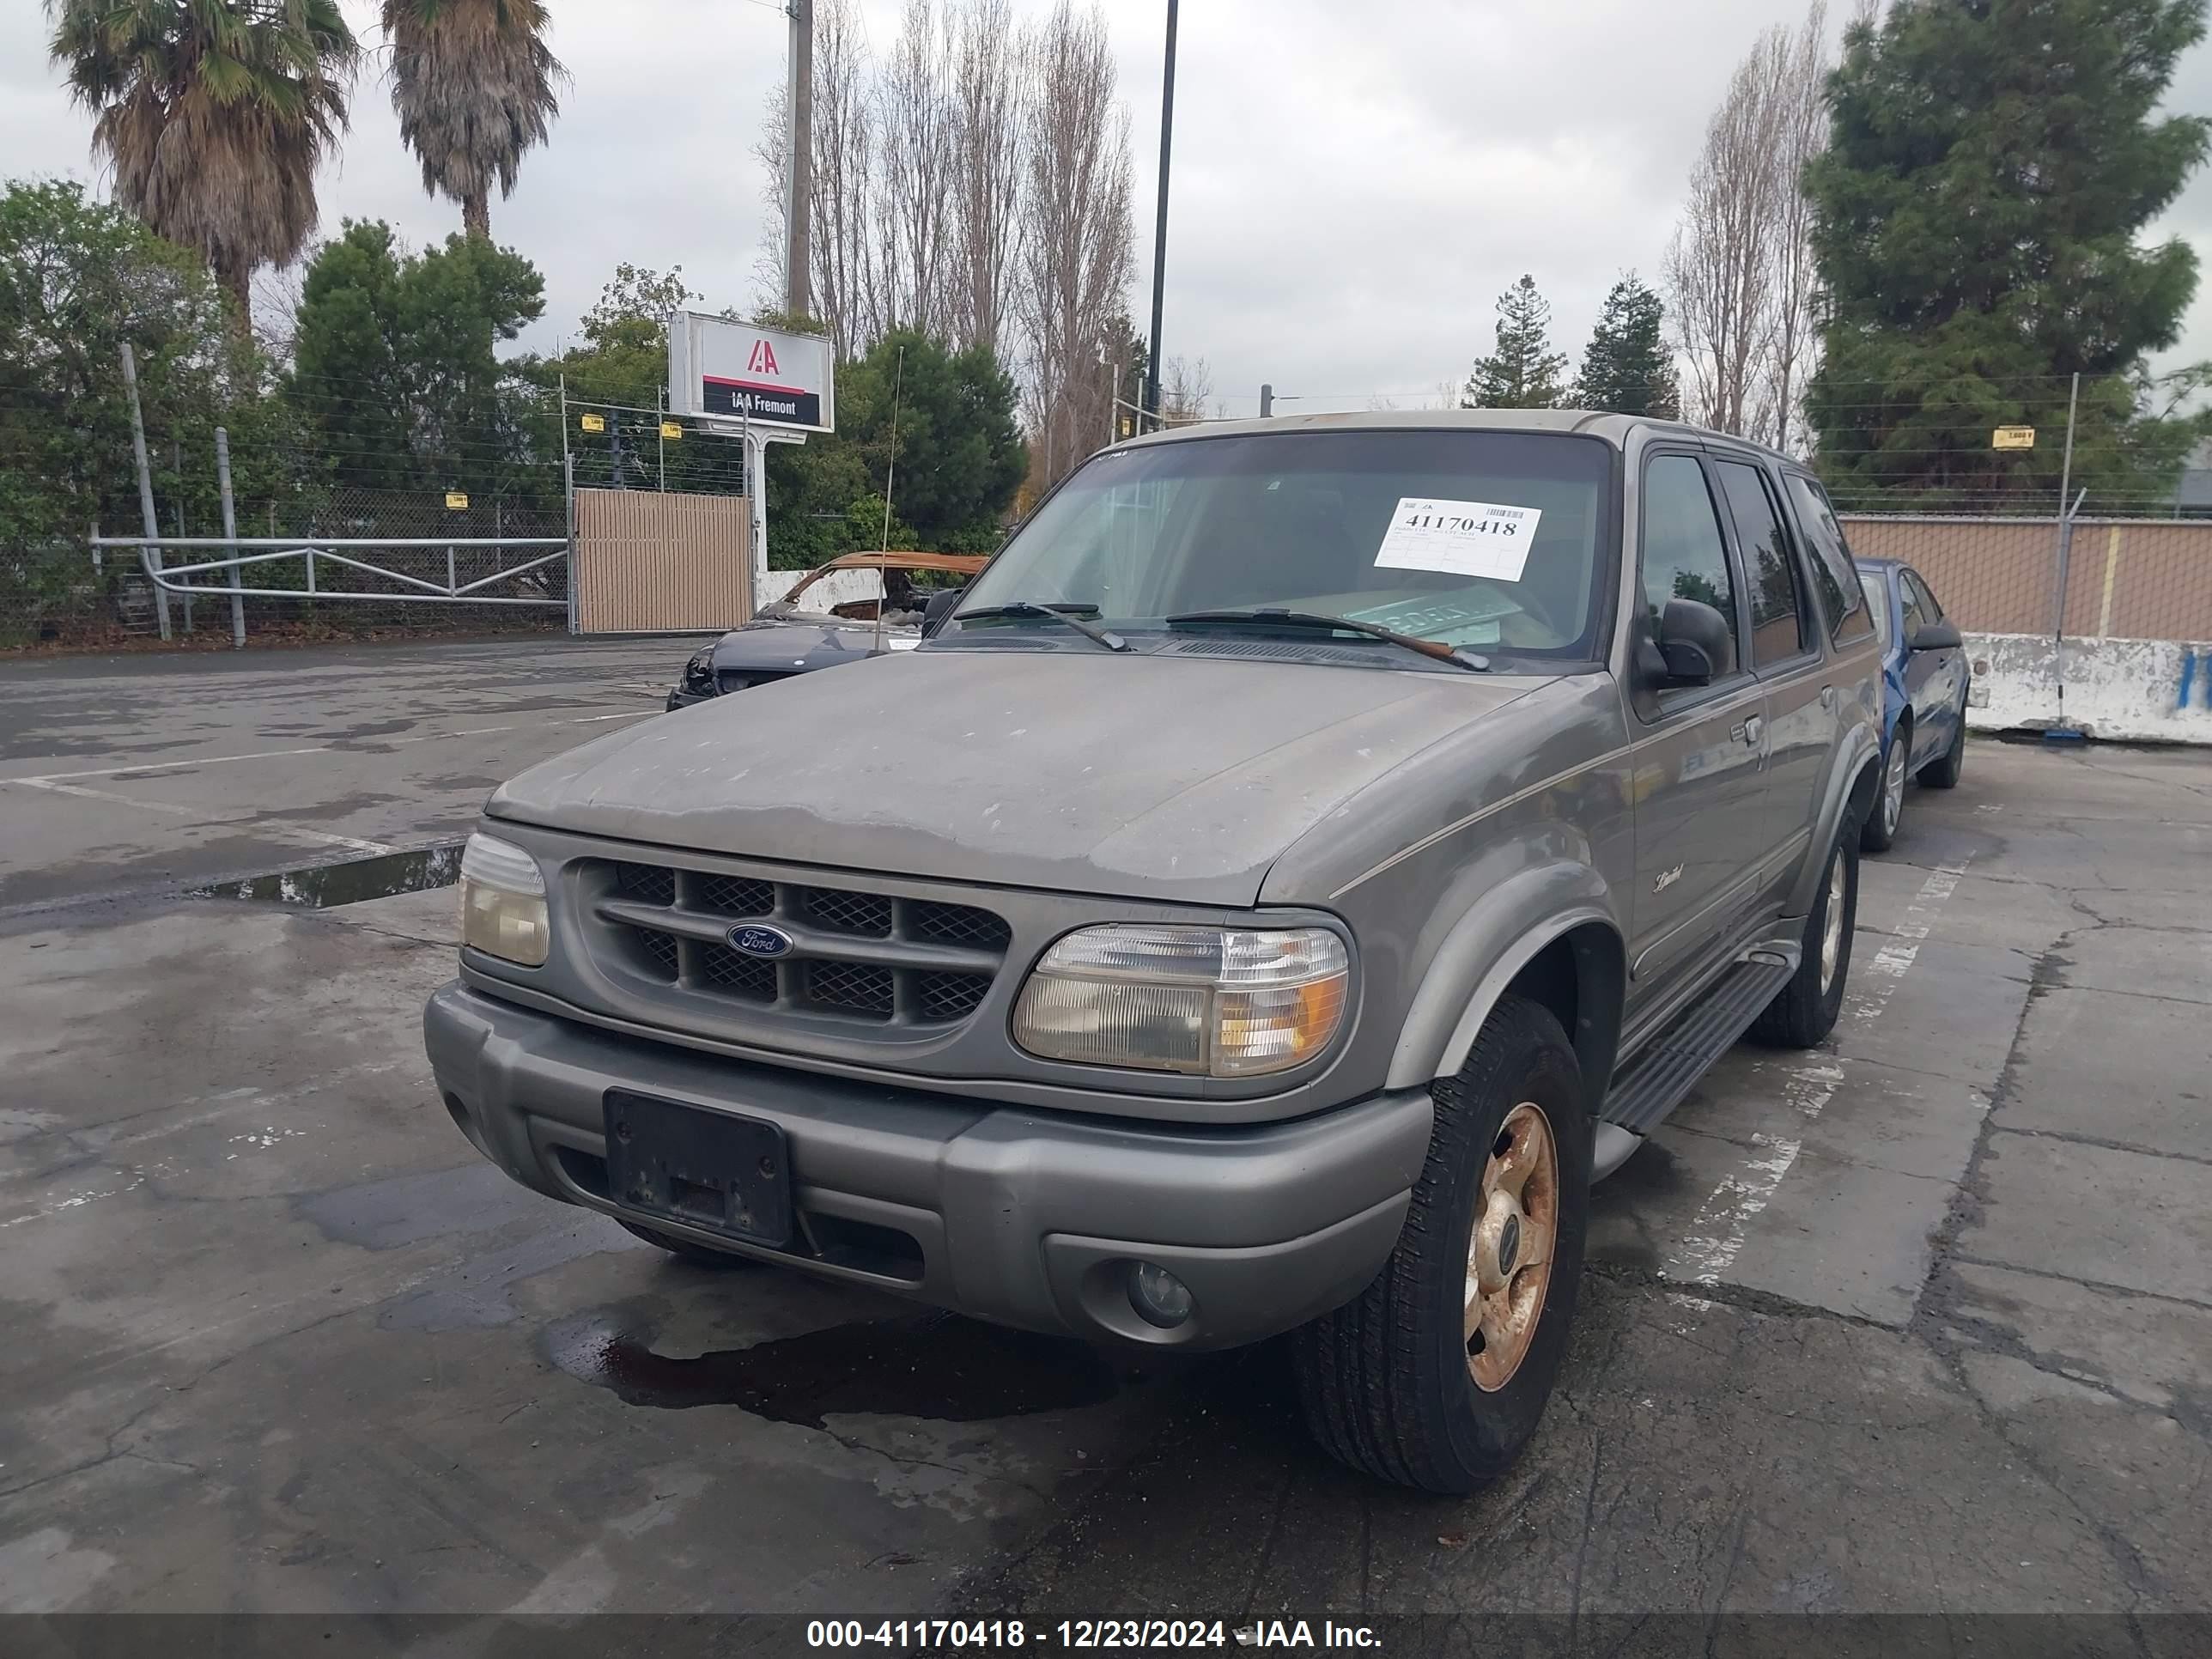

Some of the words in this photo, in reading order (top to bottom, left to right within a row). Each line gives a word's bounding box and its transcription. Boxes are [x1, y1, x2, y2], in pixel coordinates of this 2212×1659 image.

[732, 392, 753, 410] IAA
[755, 394, 797, 416] Fremont
[1406, 514, 1517, 536] 41170418
[741, 929, 777, 951] Ford
